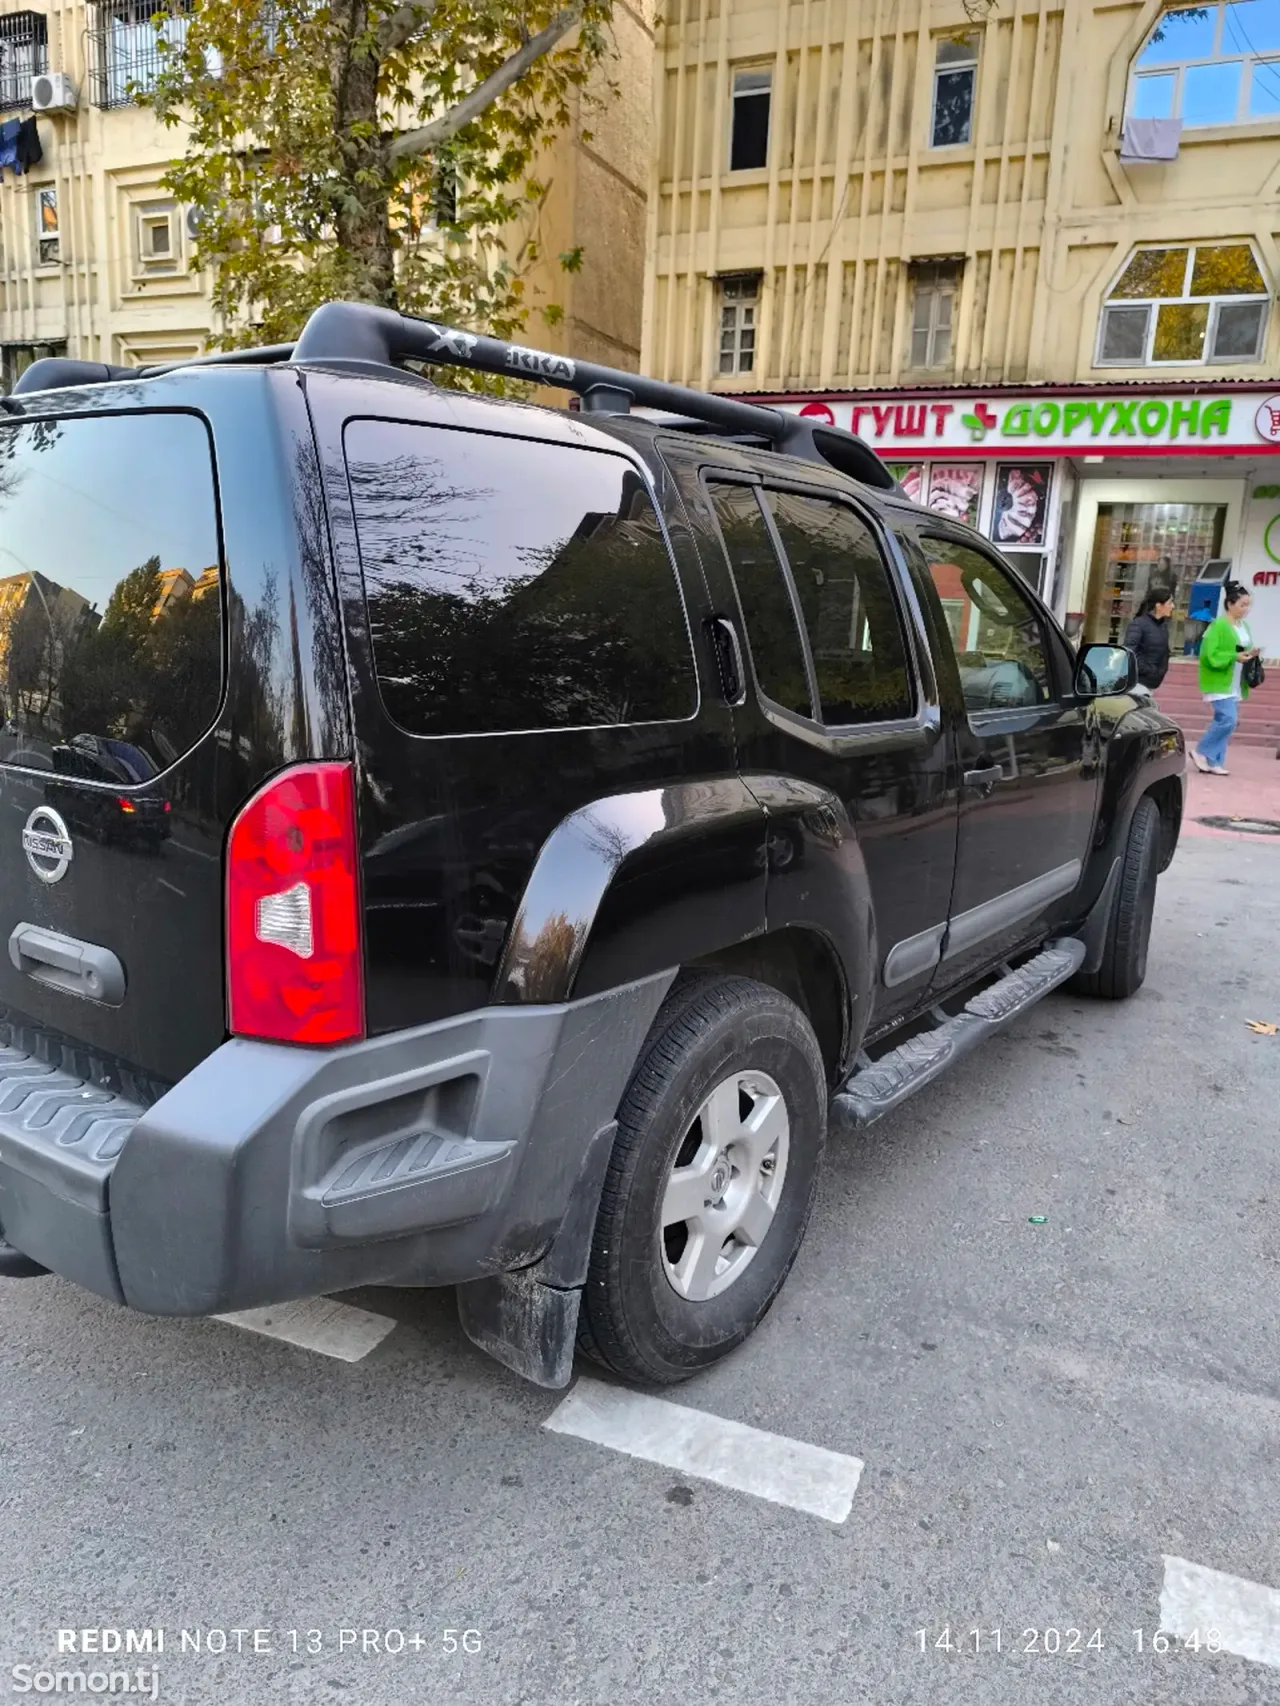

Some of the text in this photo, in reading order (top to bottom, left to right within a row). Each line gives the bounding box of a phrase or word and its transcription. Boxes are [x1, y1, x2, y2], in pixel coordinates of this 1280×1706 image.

[851, 399, 1233, 439] ГУШТ ДОРУХОНА
[1253, 571, 1280, 587] АП
[24, 833, 65, 855] NISSAN
